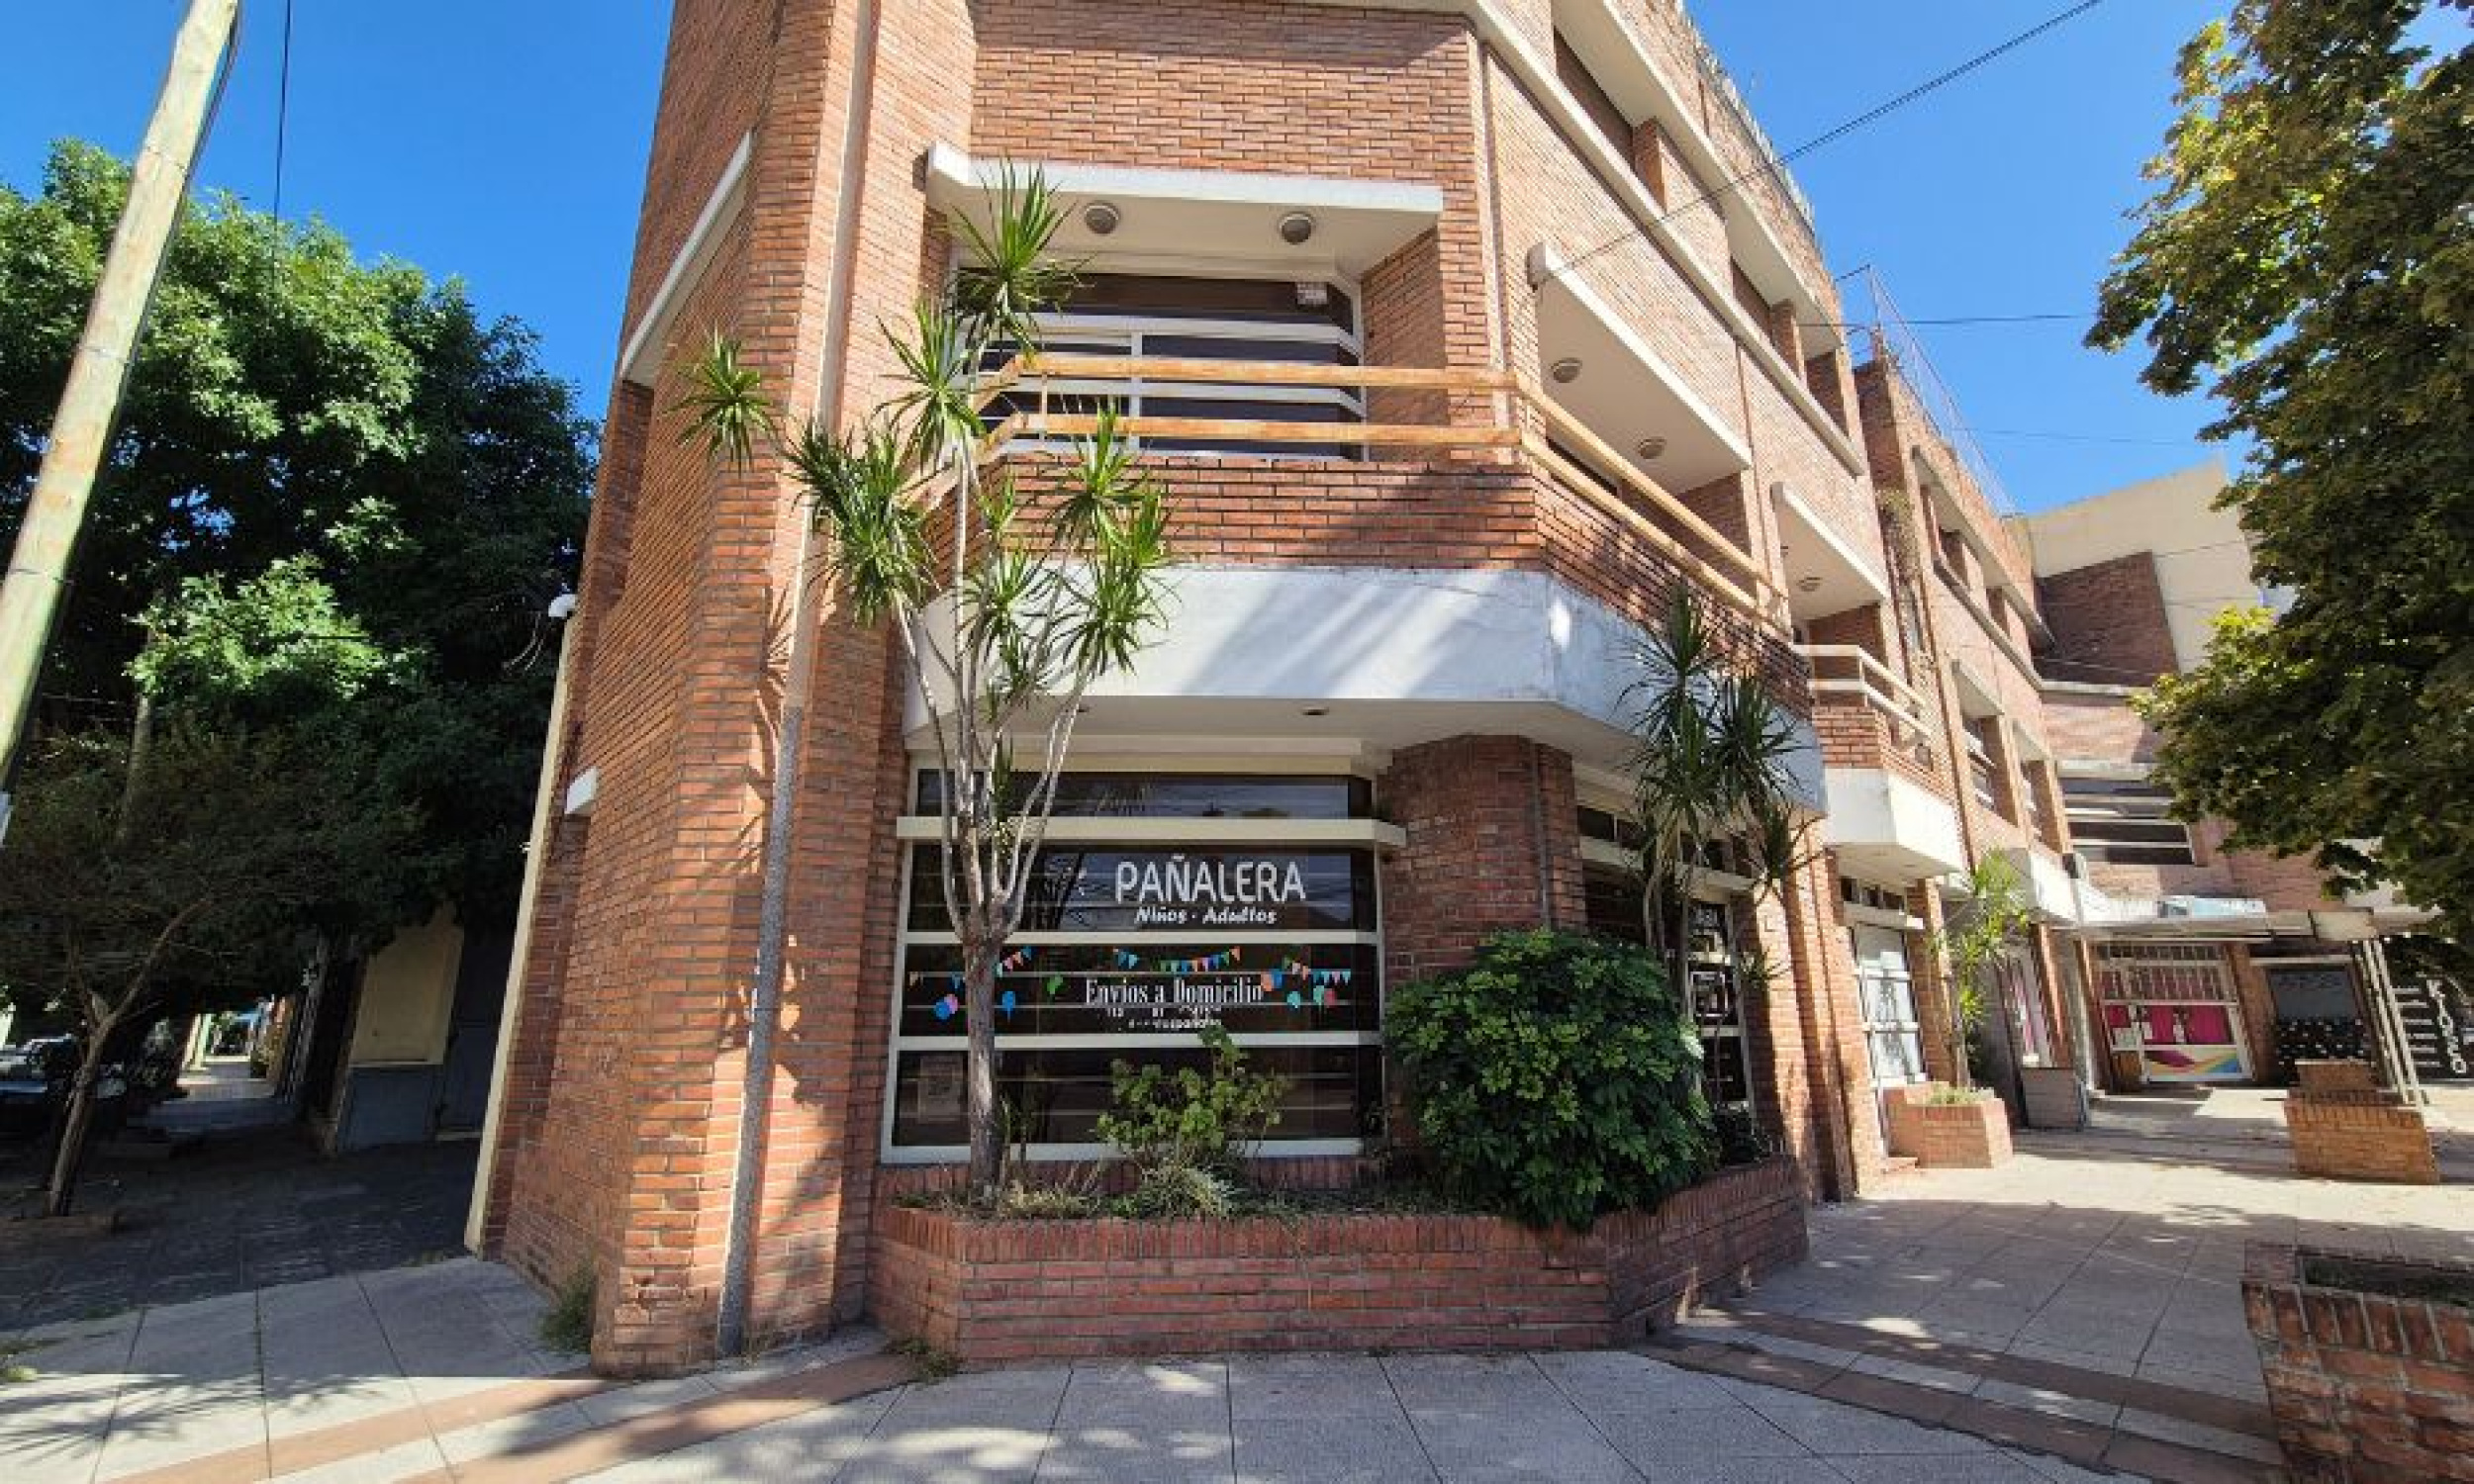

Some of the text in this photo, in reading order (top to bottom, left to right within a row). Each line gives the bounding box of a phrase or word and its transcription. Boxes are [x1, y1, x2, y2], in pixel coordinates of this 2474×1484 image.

[1115, 854, 1306, 903] PAÑALERA
[1135, 906, 1188, 924] Niños
[1201, 906, 1278, 924] Adultos
[1155, 985, 1164, 1003] a
[1174, 976, 1264, 1003] Domicilio
